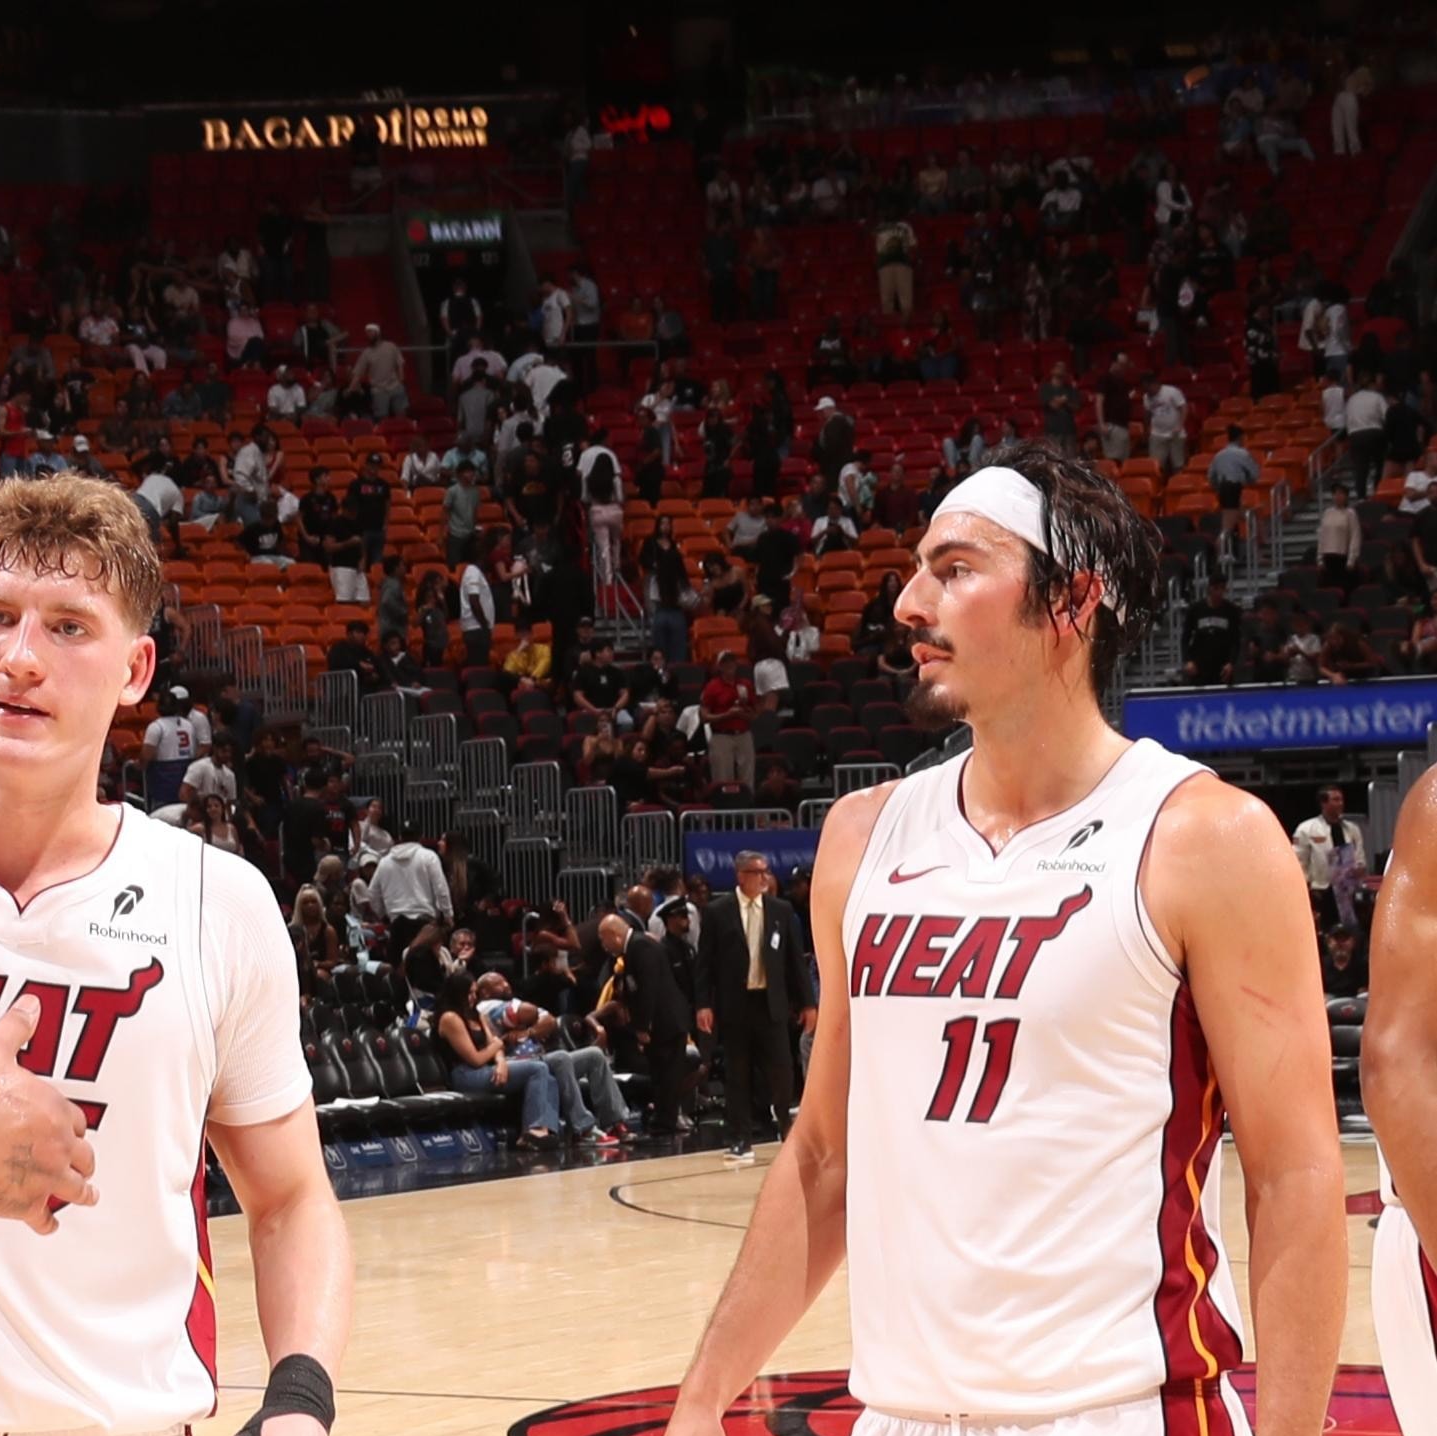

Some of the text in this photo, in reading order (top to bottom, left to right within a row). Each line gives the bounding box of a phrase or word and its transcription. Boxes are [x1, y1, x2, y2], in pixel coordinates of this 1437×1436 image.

[1177, 700, 1431, 743] ticketmaster
[1036, 860, 1106, 874] Robinhood
[88, 922, 168, 946] Robinhood
[850, 883, 1093, 1000] HEAT
[924, 1014, 1021, 1124] 11
